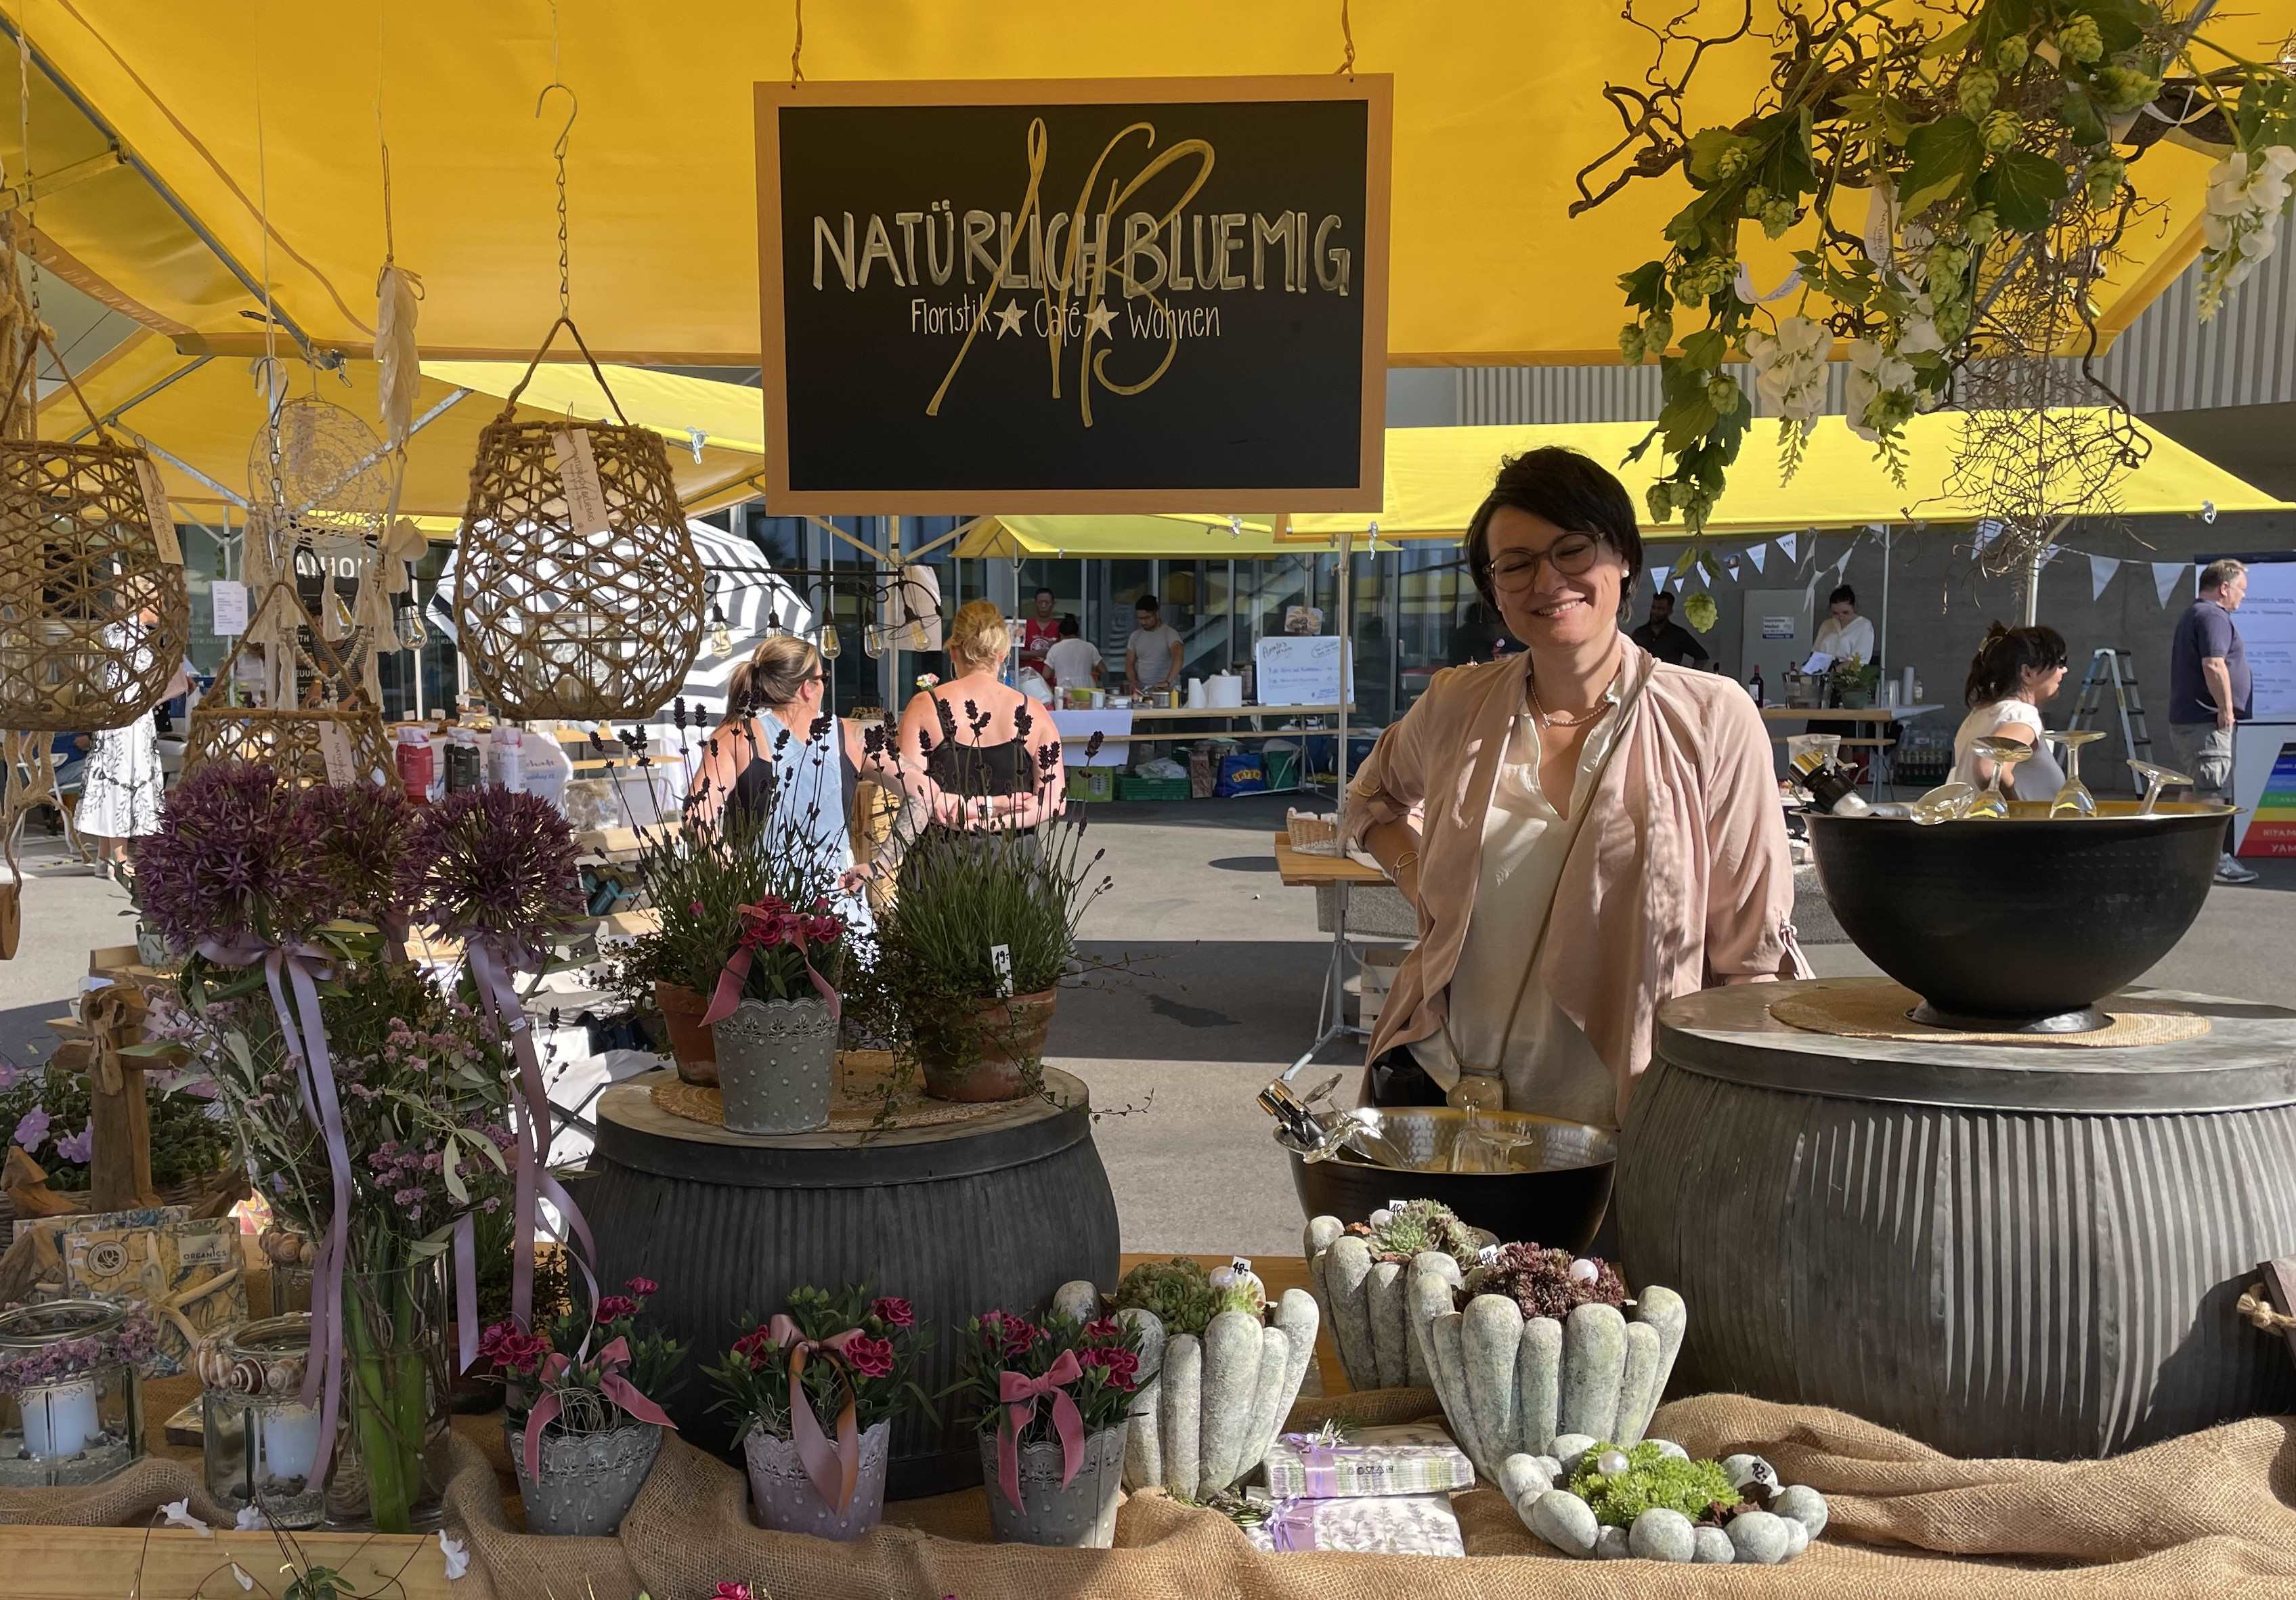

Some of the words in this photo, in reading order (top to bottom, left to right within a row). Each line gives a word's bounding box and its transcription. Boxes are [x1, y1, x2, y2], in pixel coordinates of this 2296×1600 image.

[813, 200, 1107, 297] NATÜRLICH
[1123, 210, 1350, 299] BLUEMIG
[911, 293, 991, 334] Floristik
[1035, 298, 1081, 347] Café
[1127, 298, 1219, 339] Wohnen
[183, 1248, 228, 1259] ORGANICS
